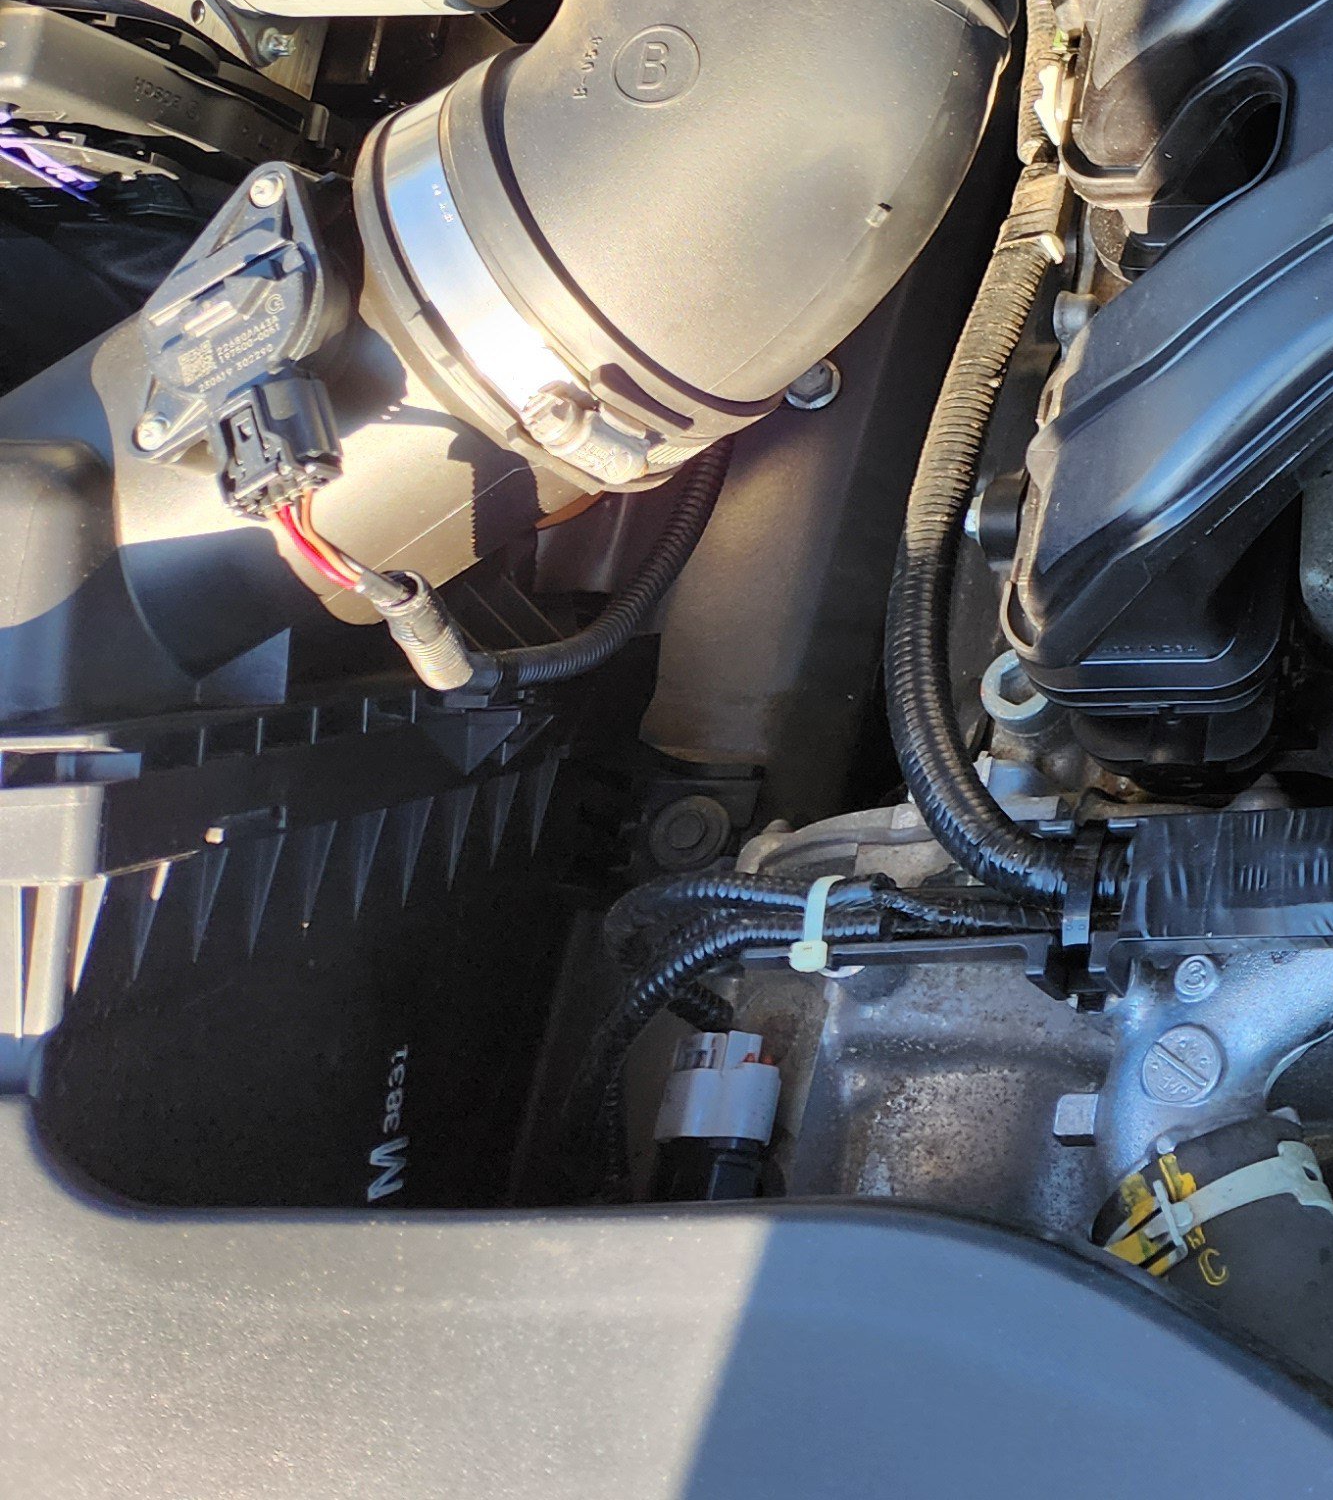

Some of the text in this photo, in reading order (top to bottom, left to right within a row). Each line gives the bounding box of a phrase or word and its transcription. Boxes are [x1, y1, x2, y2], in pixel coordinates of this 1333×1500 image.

[636, 41, 670, 90] B
[1184, 960, 1207, 991] 3
[1198, 1248, 1230, 1286] C
